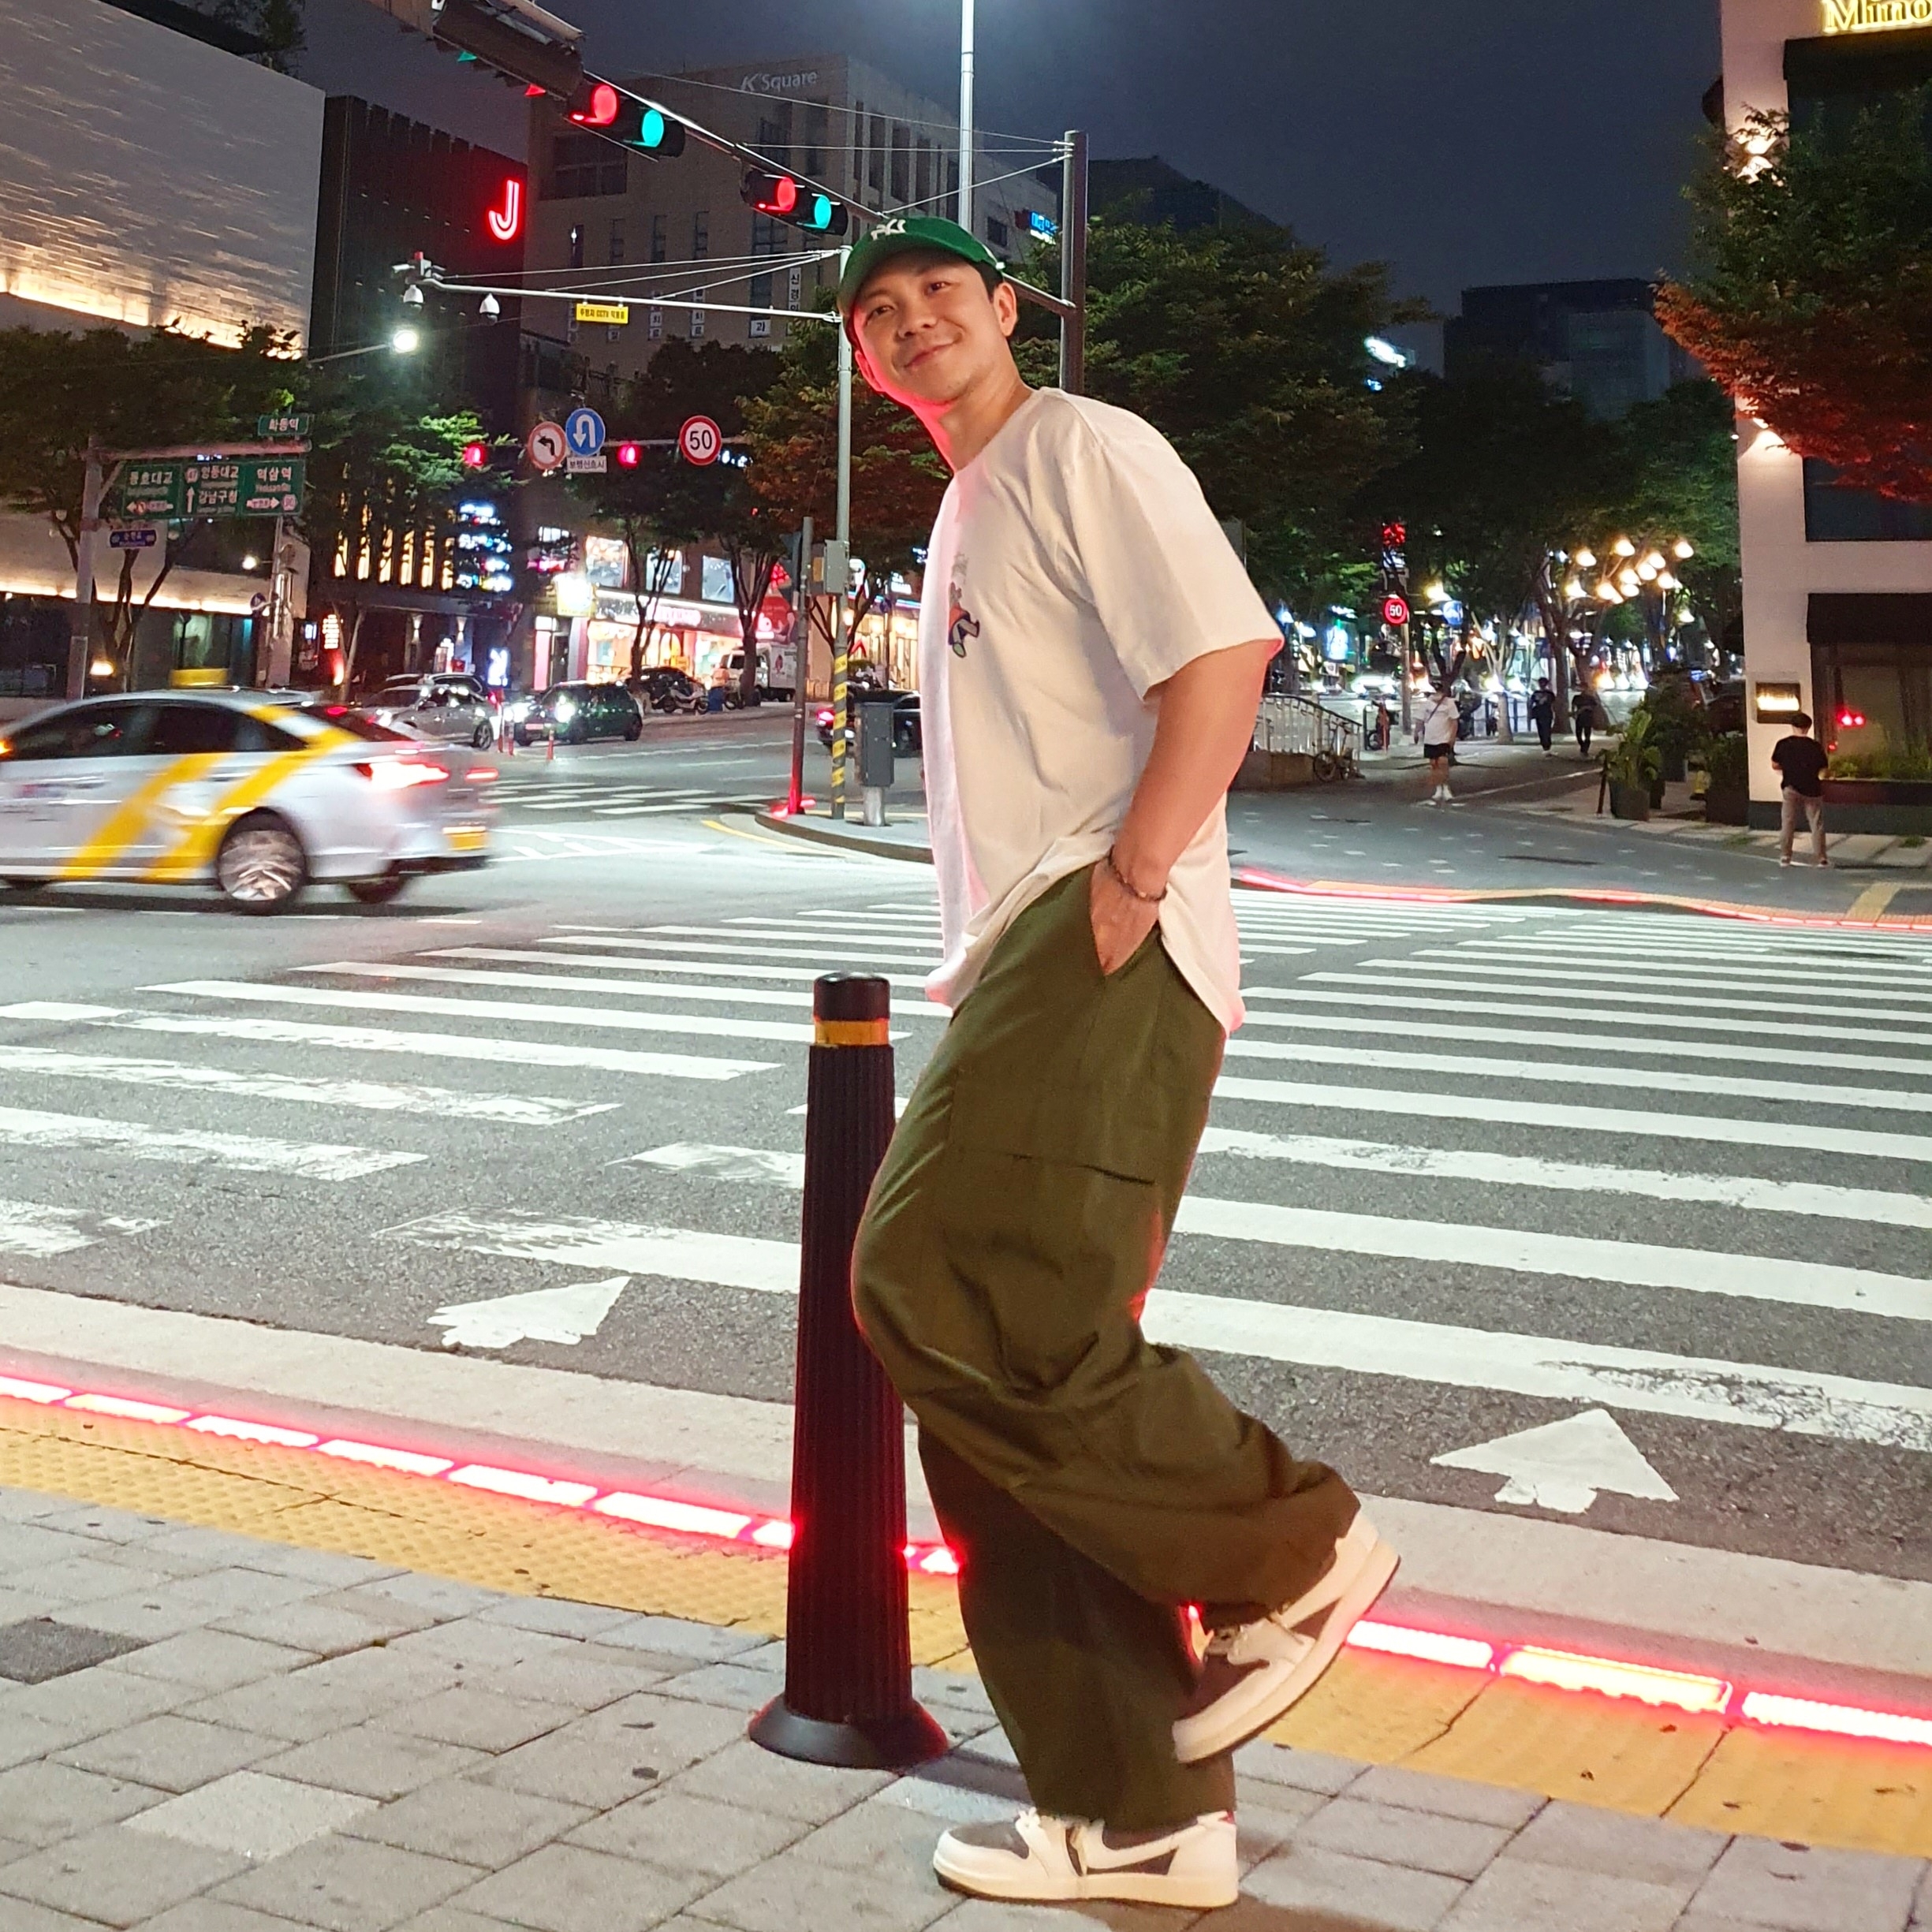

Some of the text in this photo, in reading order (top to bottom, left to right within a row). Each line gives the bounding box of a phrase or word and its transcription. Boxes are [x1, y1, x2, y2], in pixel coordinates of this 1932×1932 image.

[488, 180, 520, 241] J
[689, 430, 713, 450] 50
[257, 466, 292, 482] 역삼역
[199, 490, 237, 505] 강남구청
[1389, 605, 1403, 617] 50
